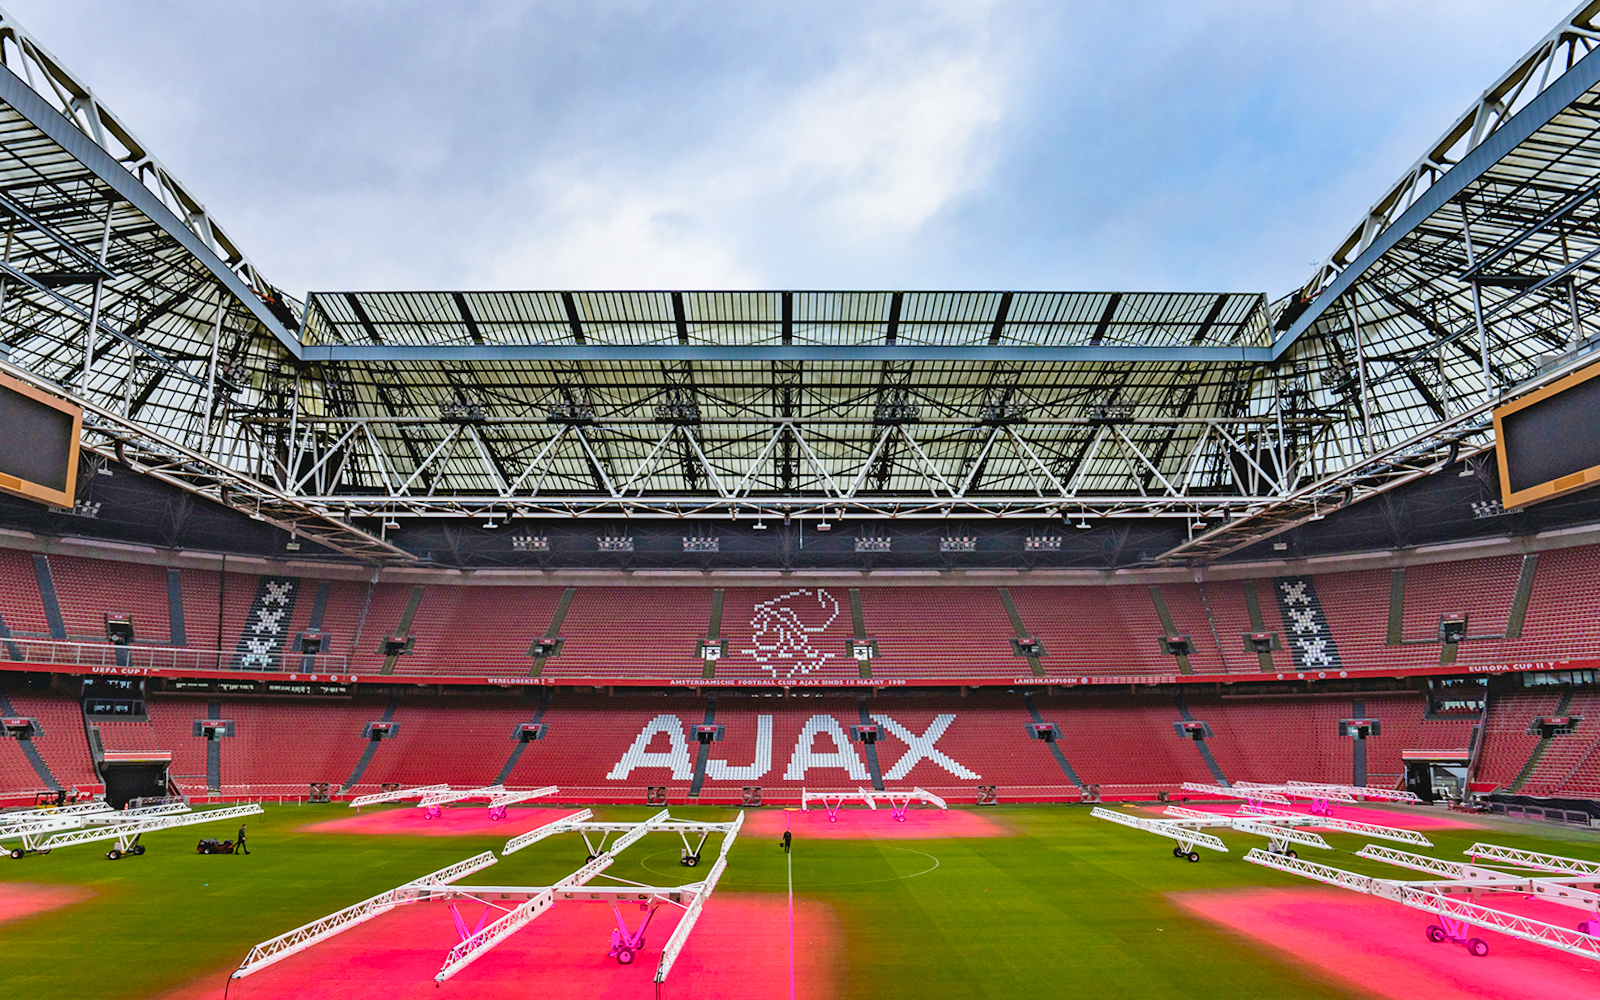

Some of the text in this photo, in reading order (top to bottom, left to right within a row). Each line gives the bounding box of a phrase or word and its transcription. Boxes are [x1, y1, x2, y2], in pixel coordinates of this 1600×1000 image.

[92, 666, 118, 674] UEFA
[1468, 664, 1510, 672] EUROPA
[606, 714, 982, 780] AJAX
